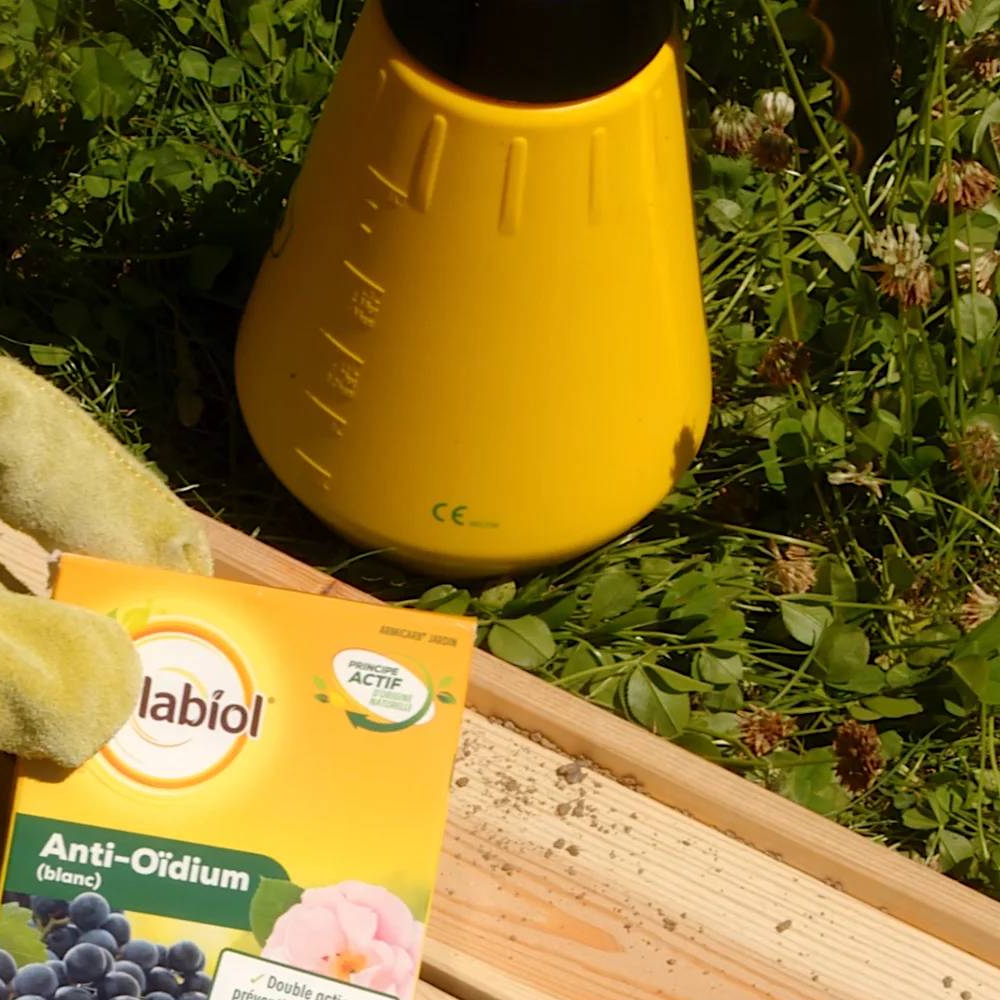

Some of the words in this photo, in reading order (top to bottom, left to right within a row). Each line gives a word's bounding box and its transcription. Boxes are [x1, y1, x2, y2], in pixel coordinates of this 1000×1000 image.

[347, 671, 403, 690] ACTIF
[348, 660, 399, 675] PRINCIPE
[138, 676, 263, 738] labiol
[39, 832, 250, 891] Anti-Oïdium
[36, 863, 102, 890] (blanc)
[266, 975, 313, 1000] Double
